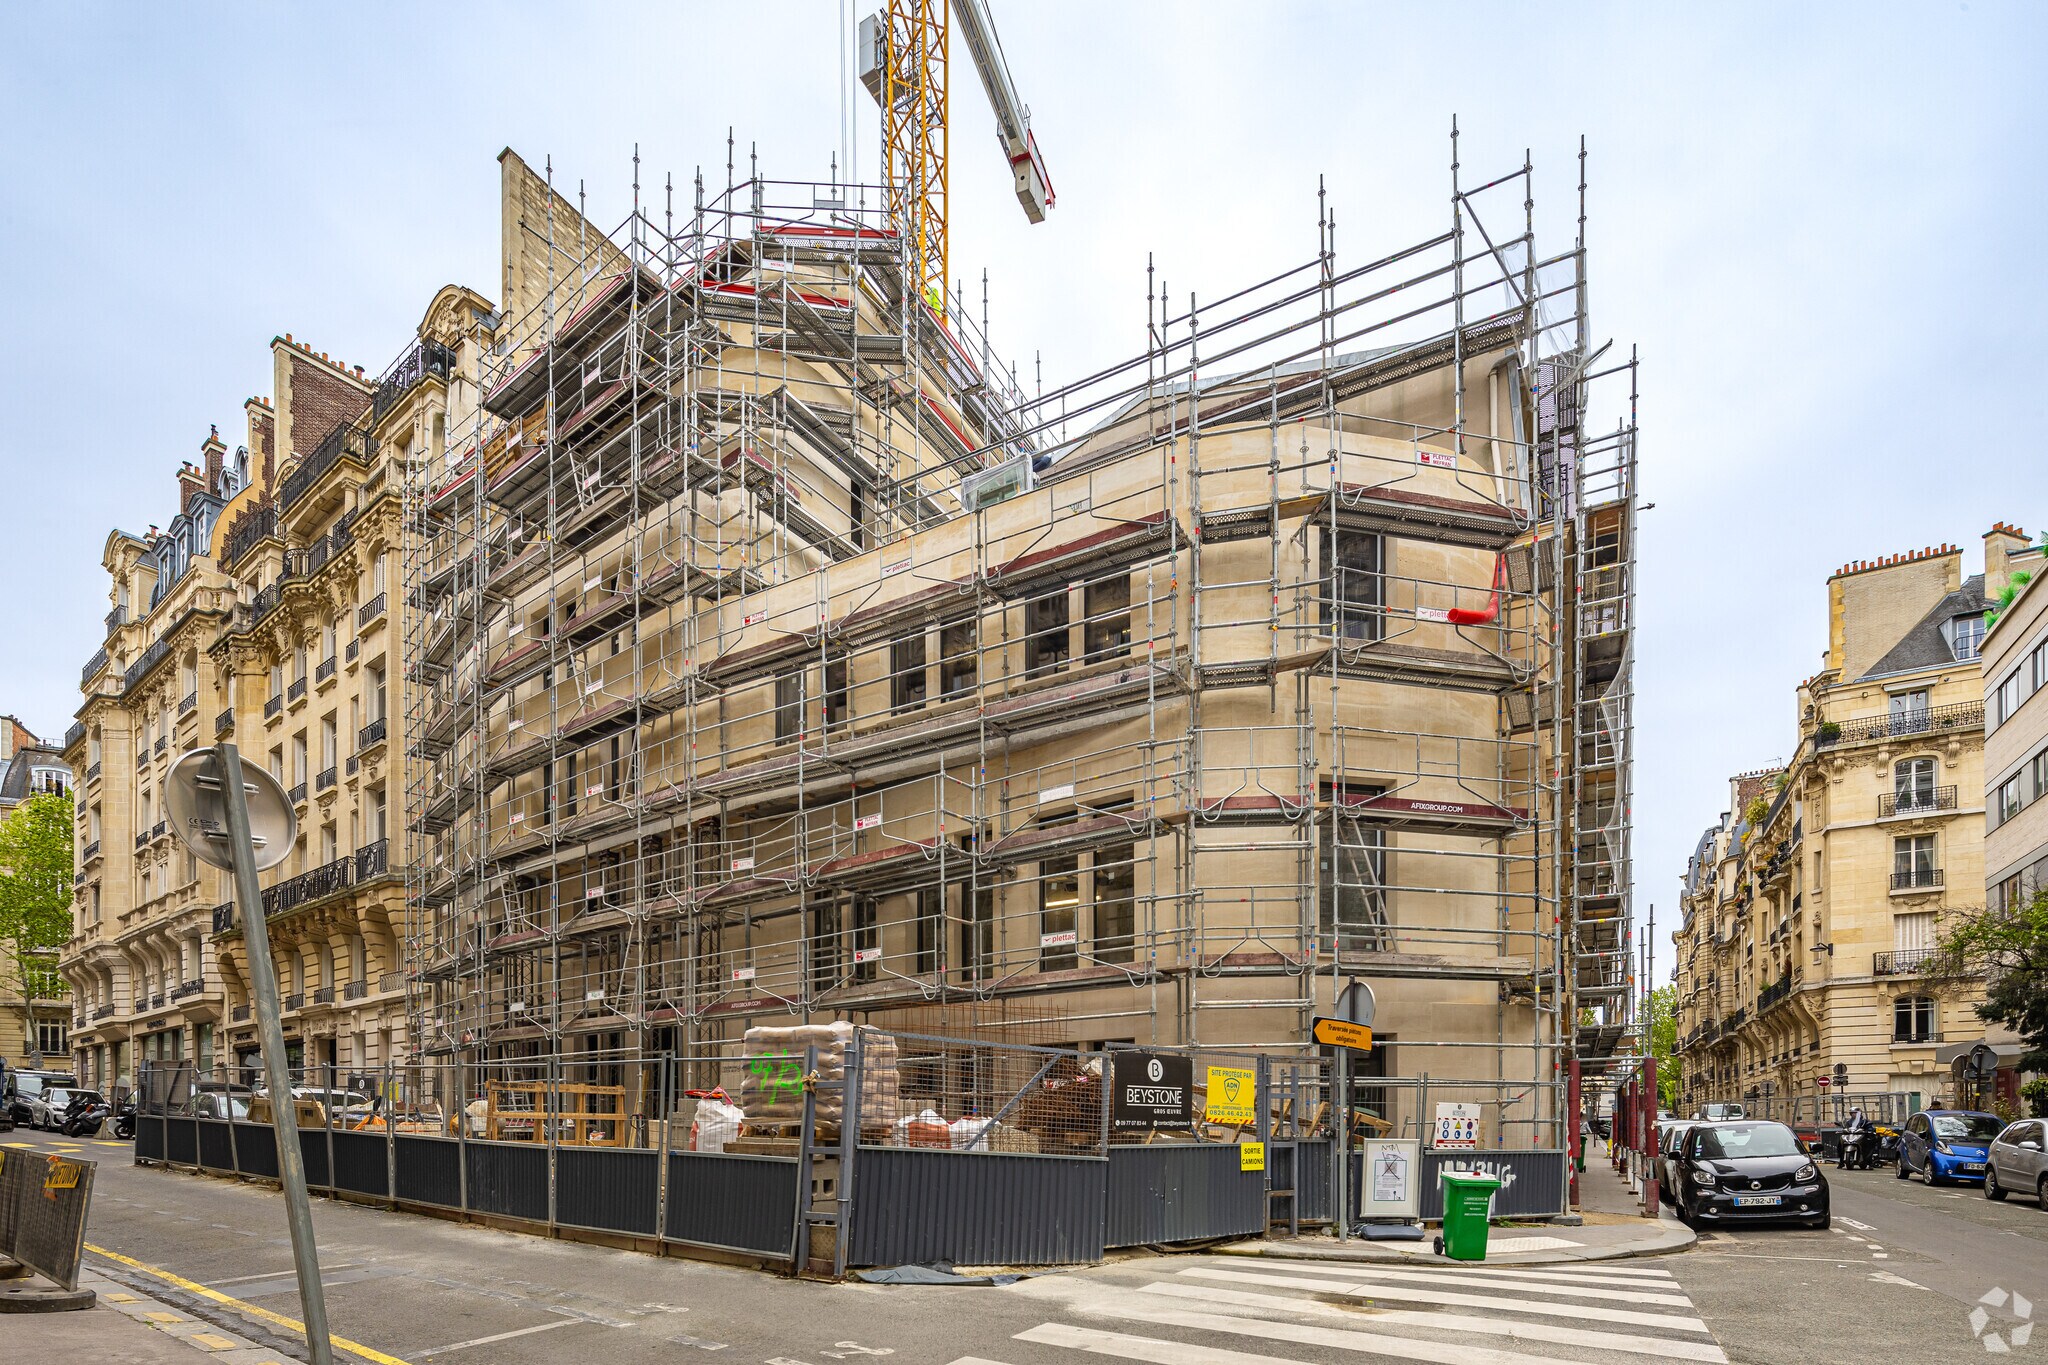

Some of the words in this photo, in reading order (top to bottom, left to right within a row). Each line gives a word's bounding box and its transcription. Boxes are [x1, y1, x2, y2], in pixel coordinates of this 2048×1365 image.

[1410, 802, 1463, 813] AFIXGROUP.COM
[1052, 933, 1076, 944] plettac
[1152, 1063, 1160, 1078] B
[1211, 1069, 1222, 1077] SITE
[1243, 1071, 1252, 1079] PAR
[1127, 1088, 1182, 1104] BEYSTONE
[1243, 1147, 1261, 1155] SORTIE
[1241, 1157, 1264, 1165] CAMIONS
[1739, 1197, 1776, 1206] EP-792-JY
